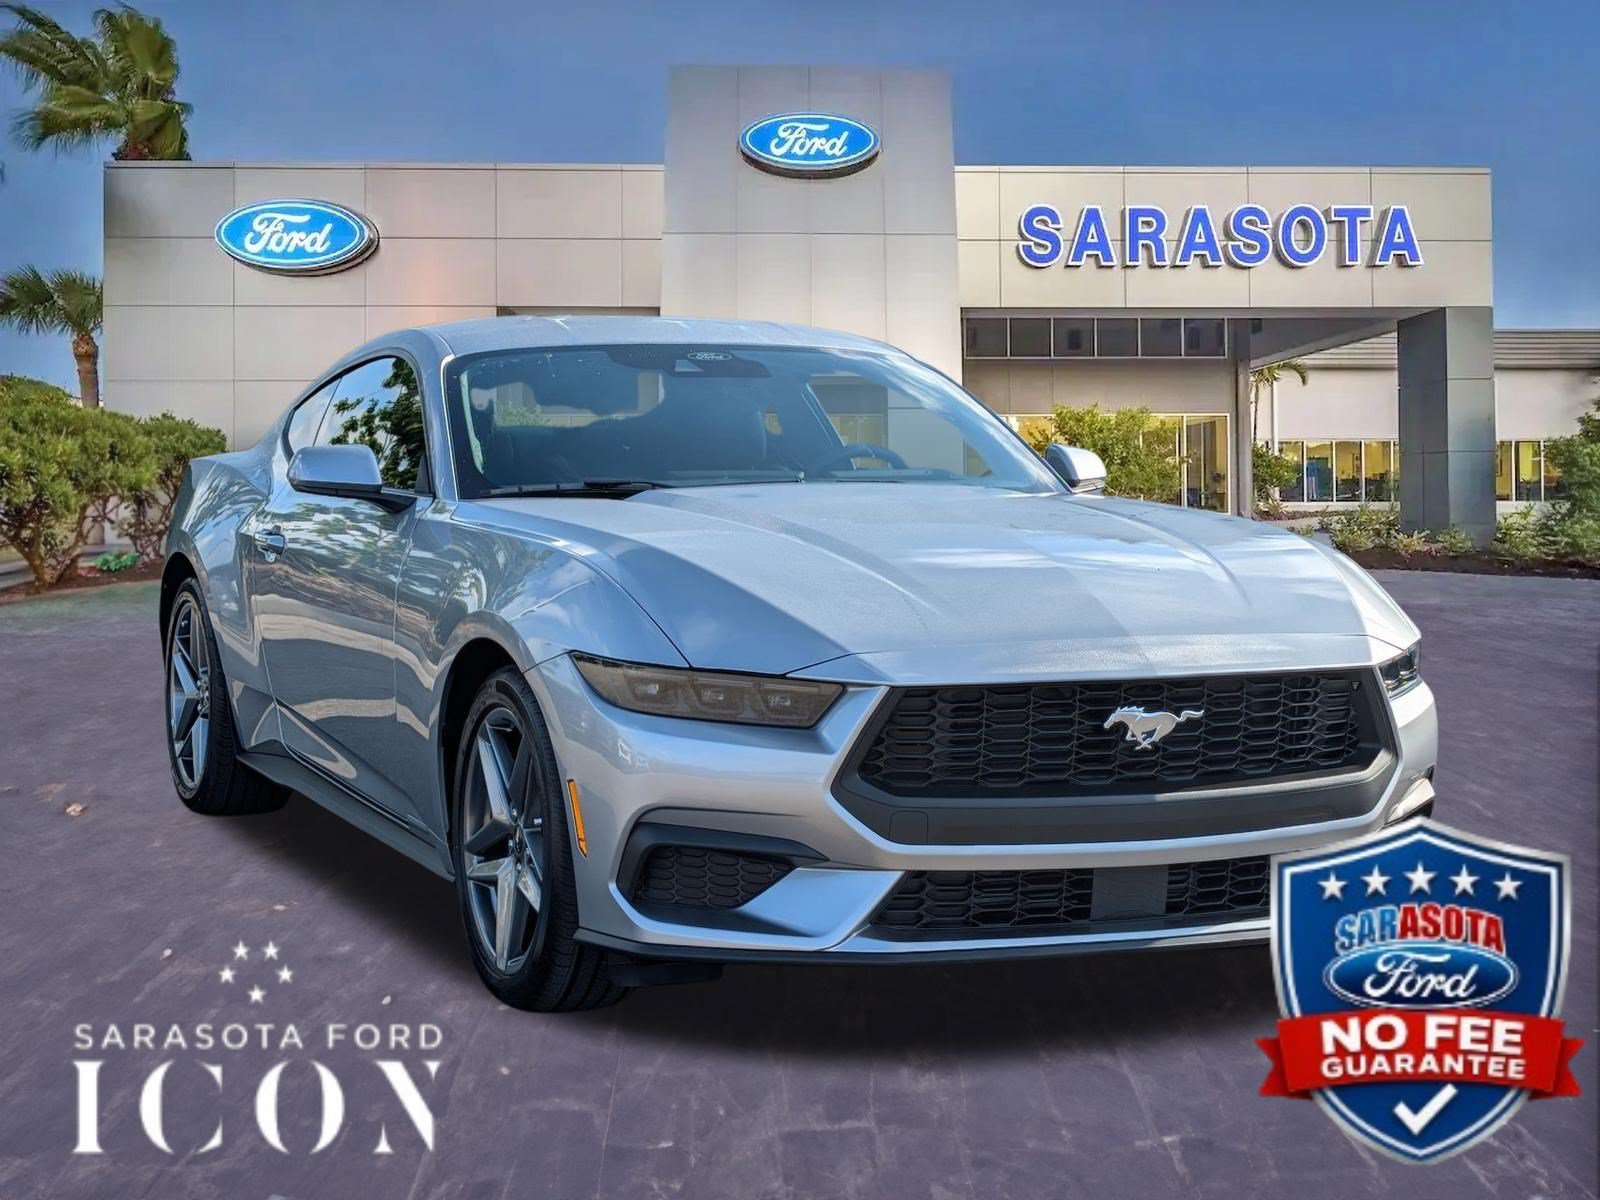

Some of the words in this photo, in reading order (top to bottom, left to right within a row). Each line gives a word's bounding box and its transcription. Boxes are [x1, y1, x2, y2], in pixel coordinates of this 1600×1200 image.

[770, 122, 847, 157] Ford
[245, 212, 332, 253] Ford
[1018, 204, 1424, 268] SARASOTA
